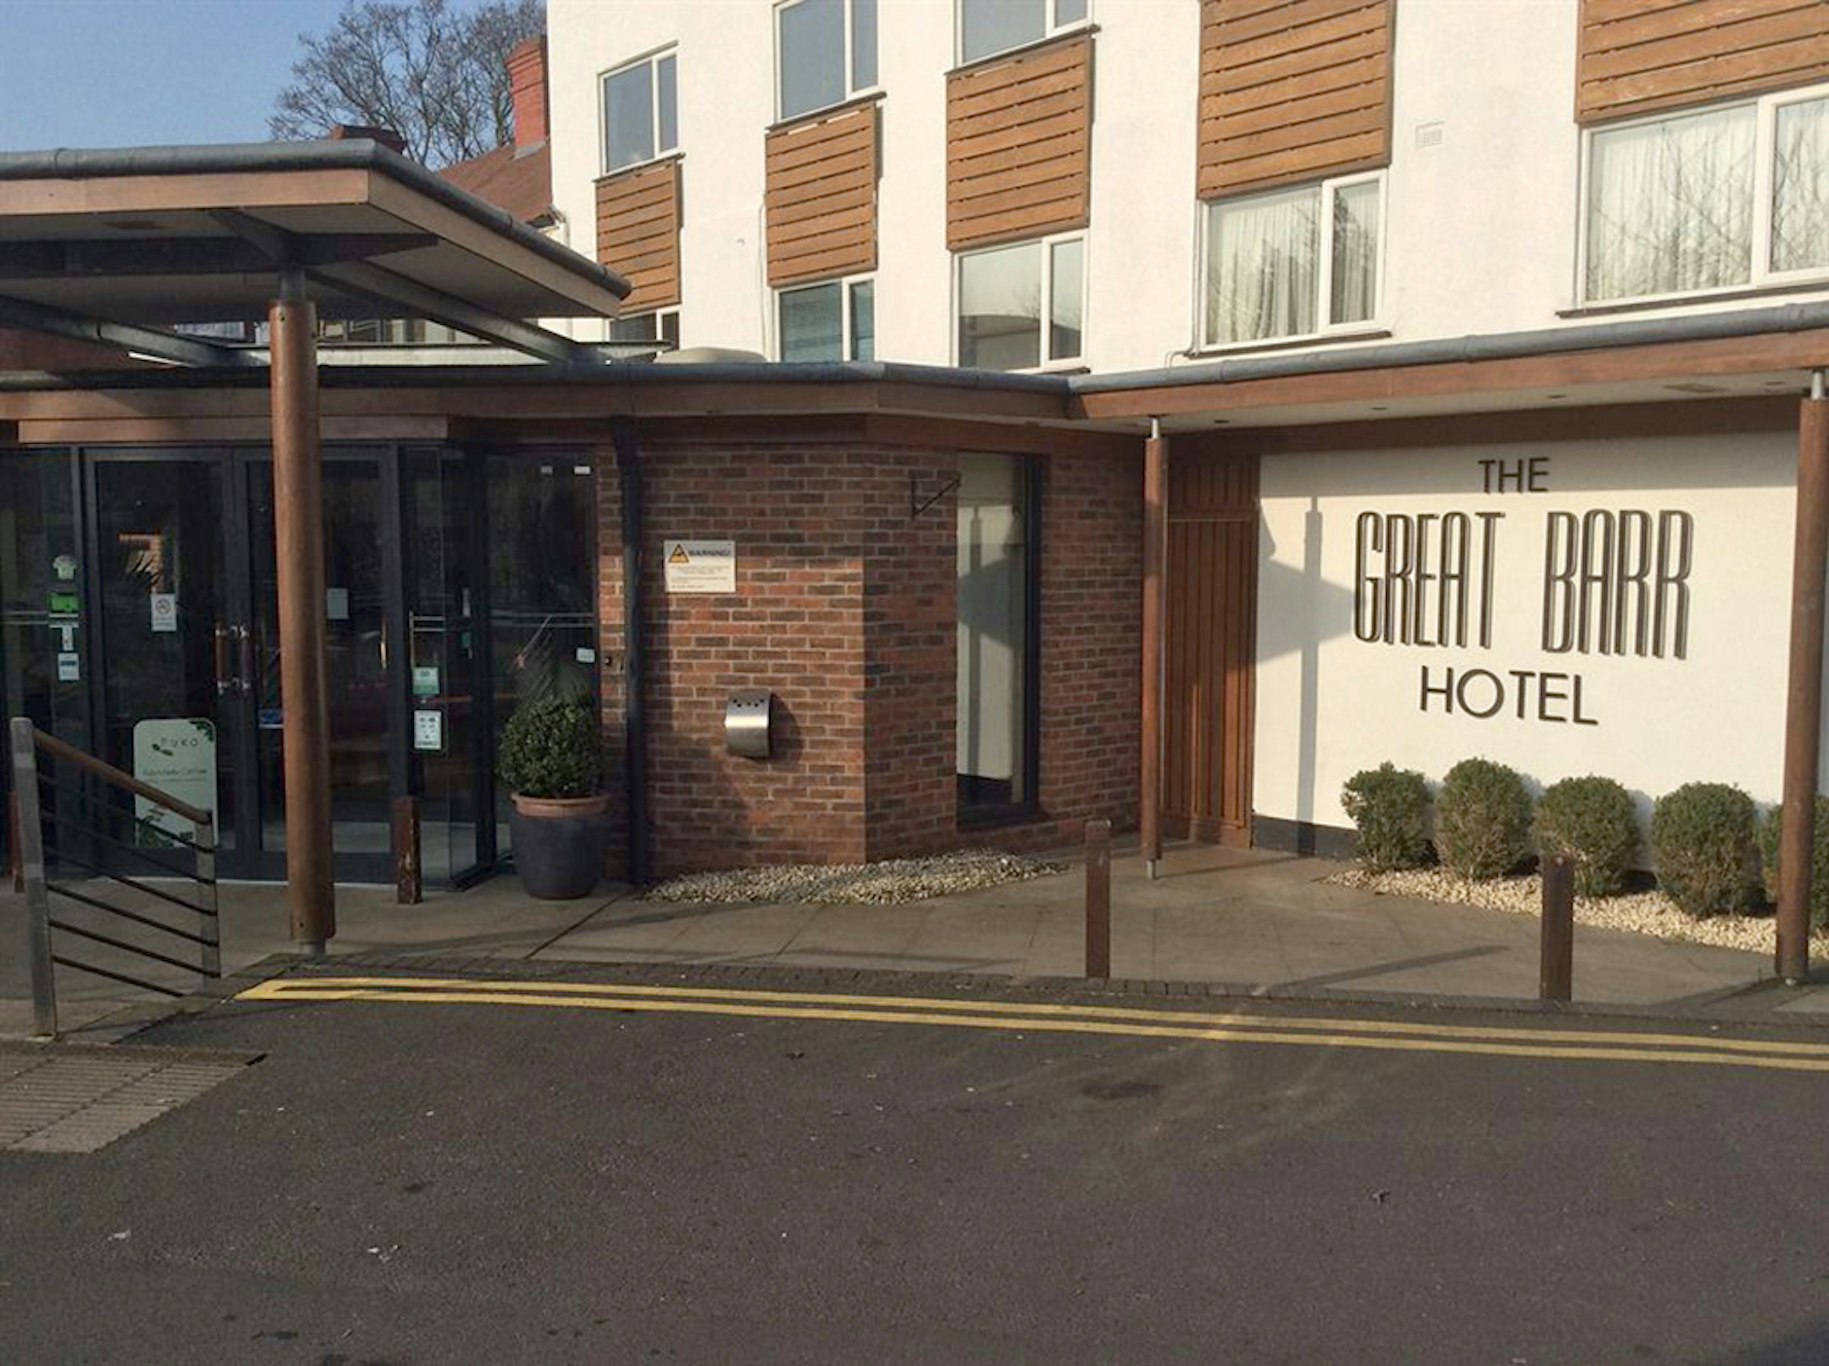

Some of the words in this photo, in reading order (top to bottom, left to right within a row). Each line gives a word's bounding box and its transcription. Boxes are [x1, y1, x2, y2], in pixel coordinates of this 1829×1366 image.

[1478, 456, 1550, 495] THE
[1353, 510, 1506, 650] GREAT
[1542, 508, 1695, 660] BARR
[1419, 665, 1599, 726] HOTEL
